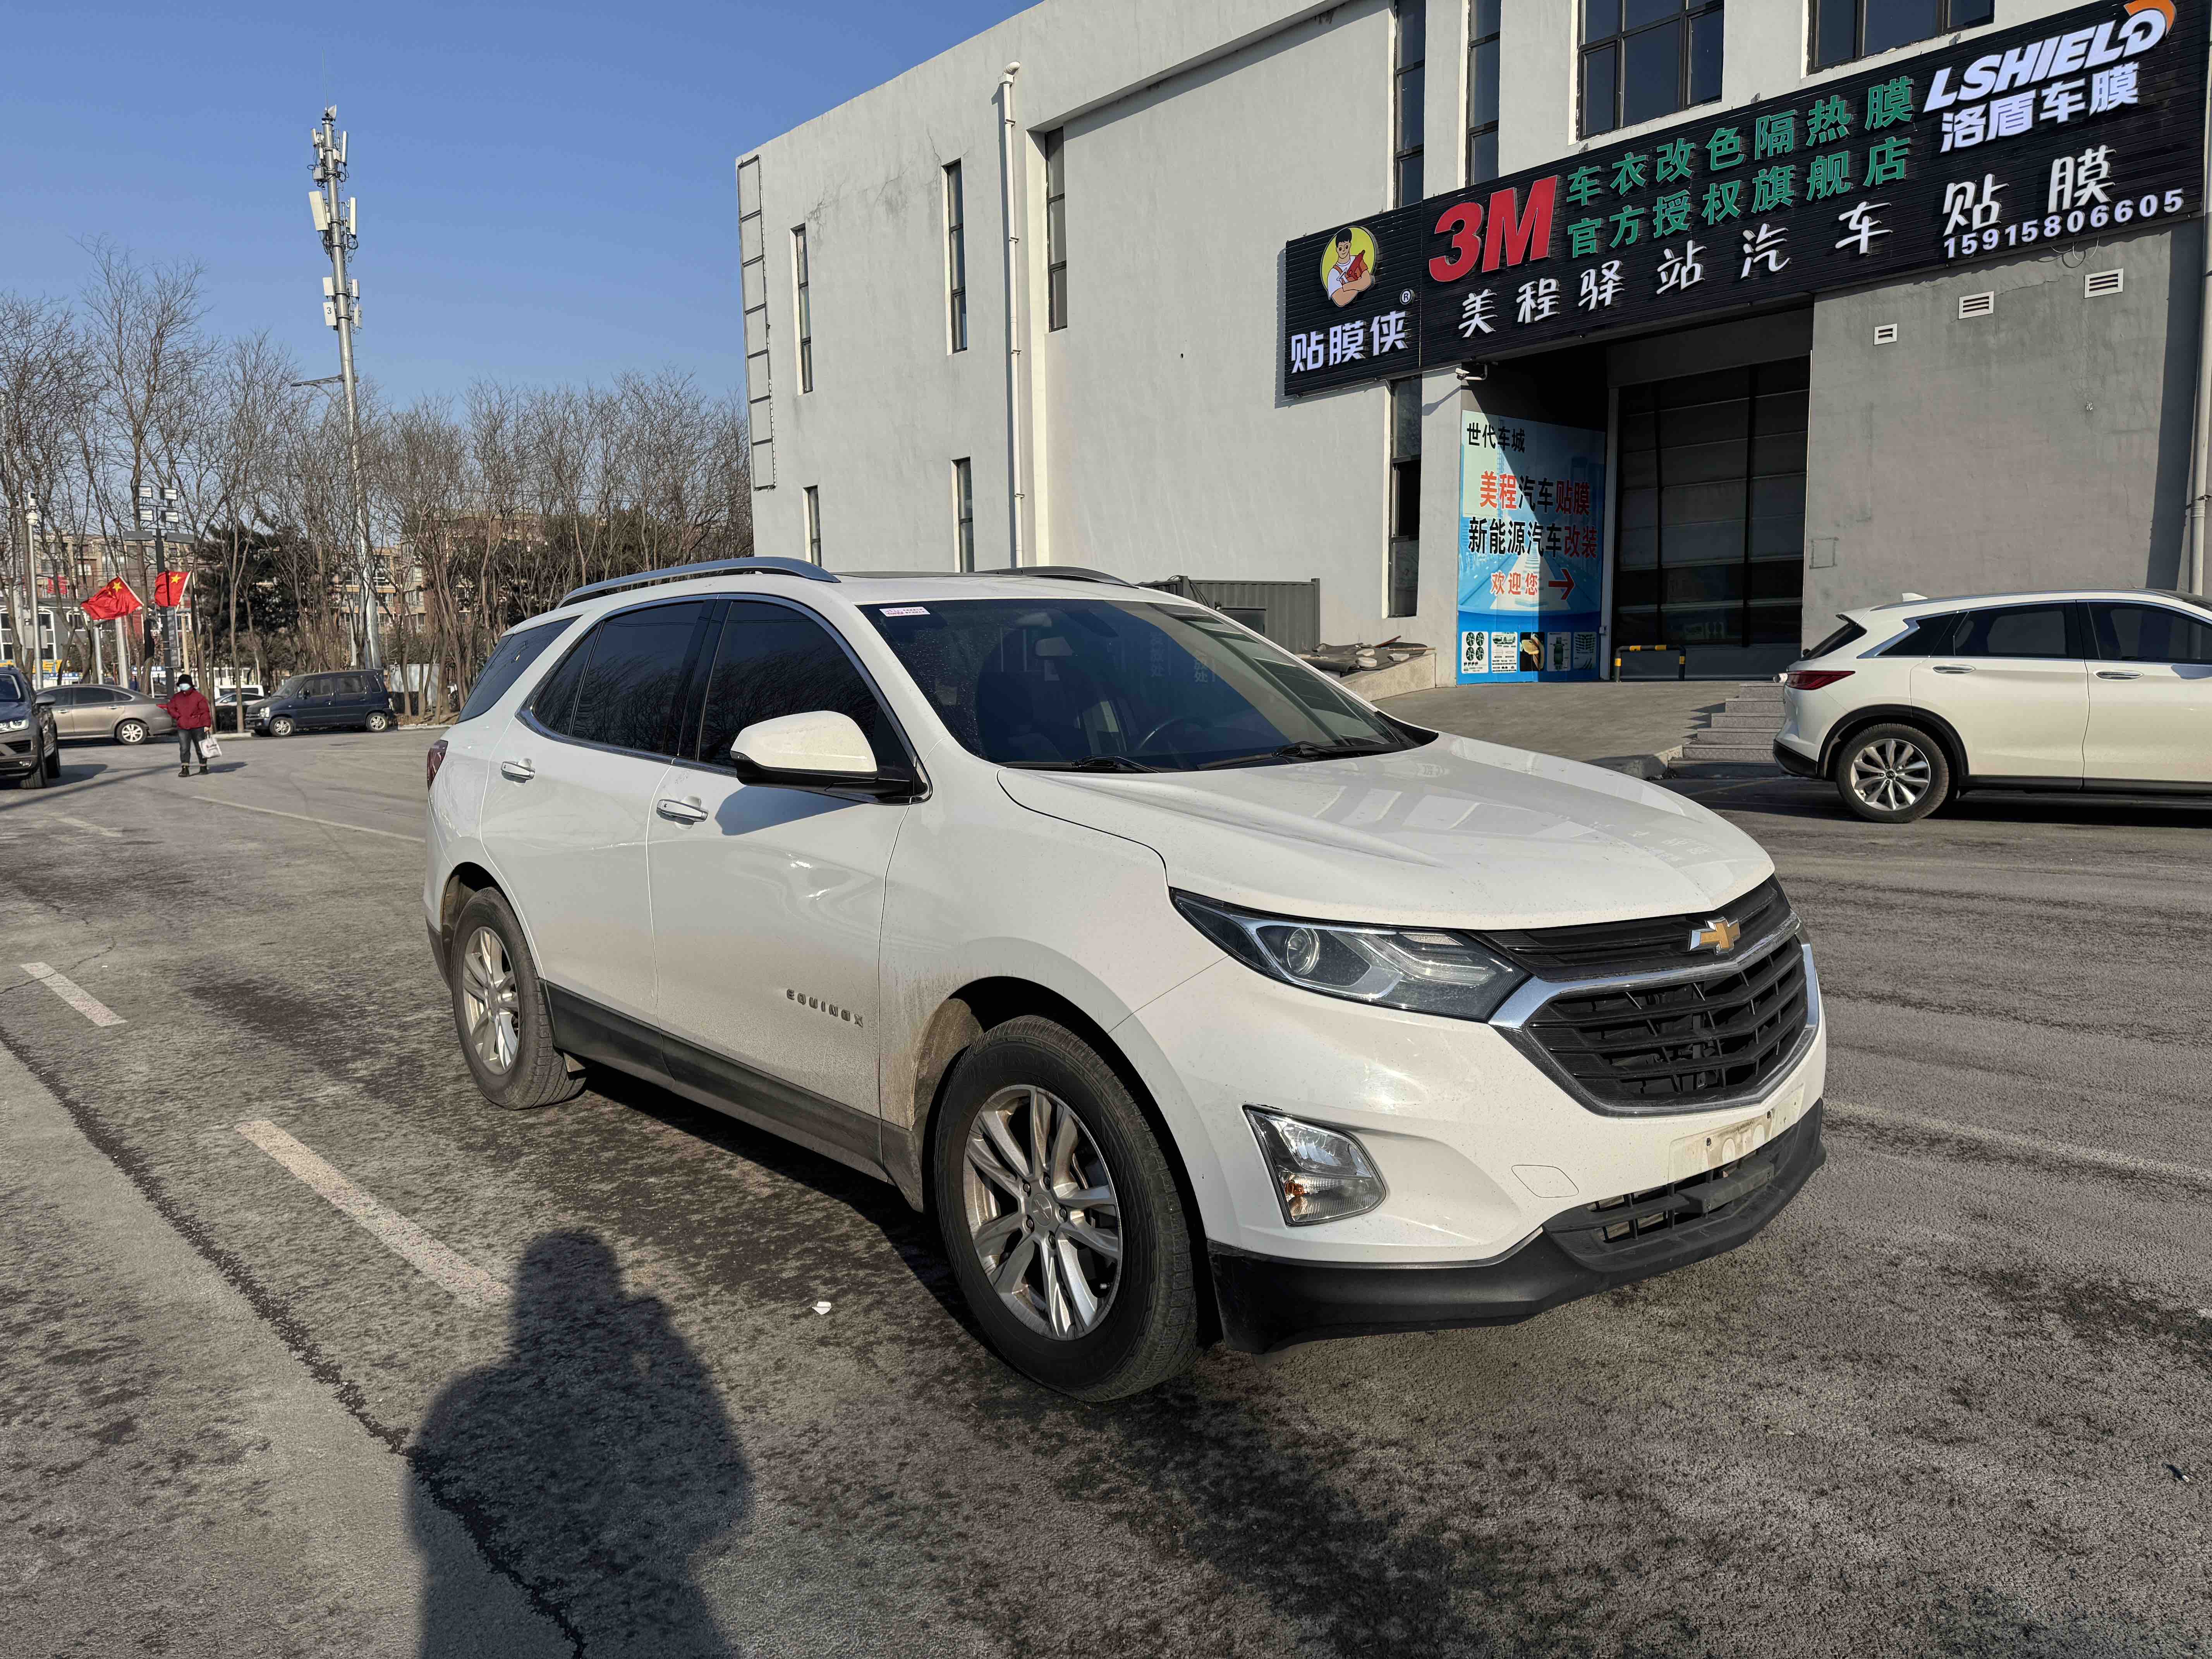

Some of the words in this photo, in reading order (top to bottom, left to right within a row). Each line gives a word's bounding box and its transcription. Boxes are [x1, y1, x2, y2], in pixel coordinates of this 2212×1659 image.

[1940, 62, 2139, 153] 洛盾车膜
[1566, 76, 1915, 206] 车衣改色隔热膜
[1429, 175, 1559, 282] 3M
[1567, 136, 1911, 258] 官方授权旗舰店
[1944, 188, 2184, 259] 15915806605
[1291, 311, 1409, 374] 贴膜侠
[1467, 422, 1525, 453] 世代车城
[1480, 470, 1590, 515] 美程汽车贴膜
[1468, 517, 1597, 558] 新能源汽车改装
[1491, 571, 1538, 595] 欢迎您
[787, 989, 864, 1028] EQUINOX
